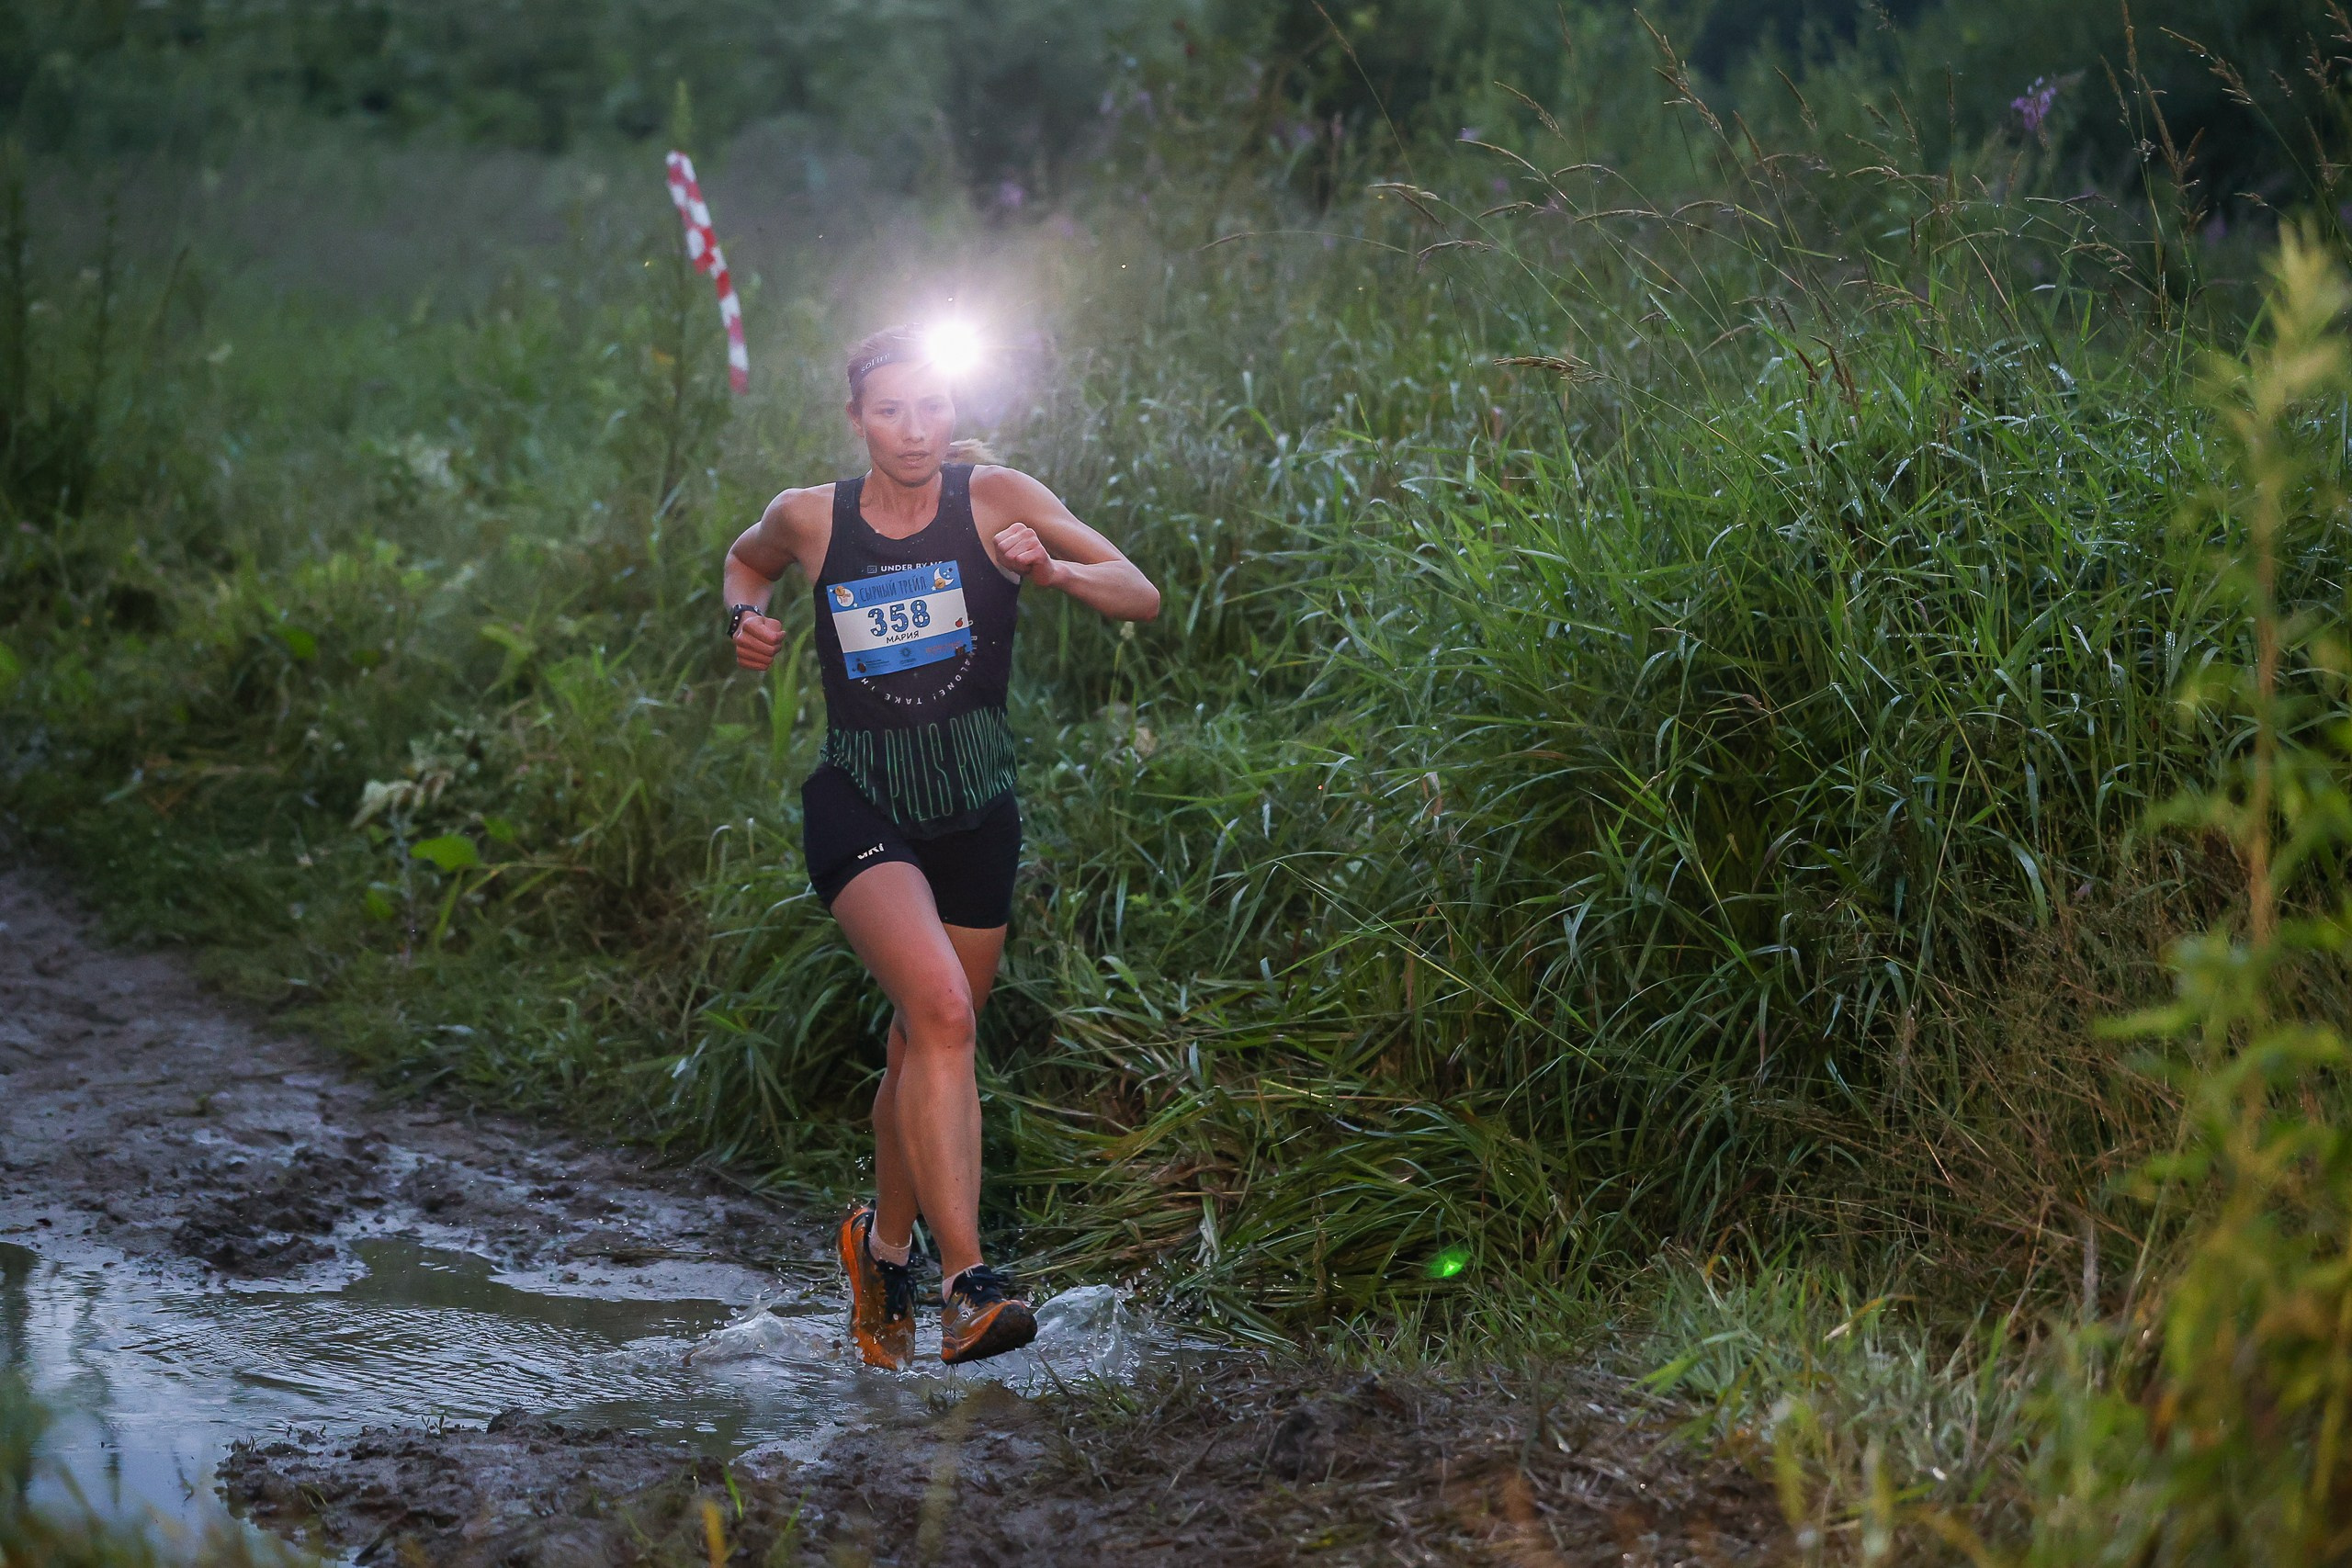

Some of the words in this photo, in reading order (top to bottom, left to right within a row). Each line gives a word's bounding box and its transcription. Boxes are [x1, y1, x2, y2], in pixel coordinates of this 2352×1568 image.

[880, 563, 913, 572] UNDER
[859, 580, 897, 602] СЫРНЫЙ
[898, 575, 927, 594] ТРЕЙЛ
[867, 599, 931, 637] 358
[886, 630, 920, 644] МАРИЯ
[884, 694, 922, 705] TAKE
[885, 722, 954, 824] PILLS
